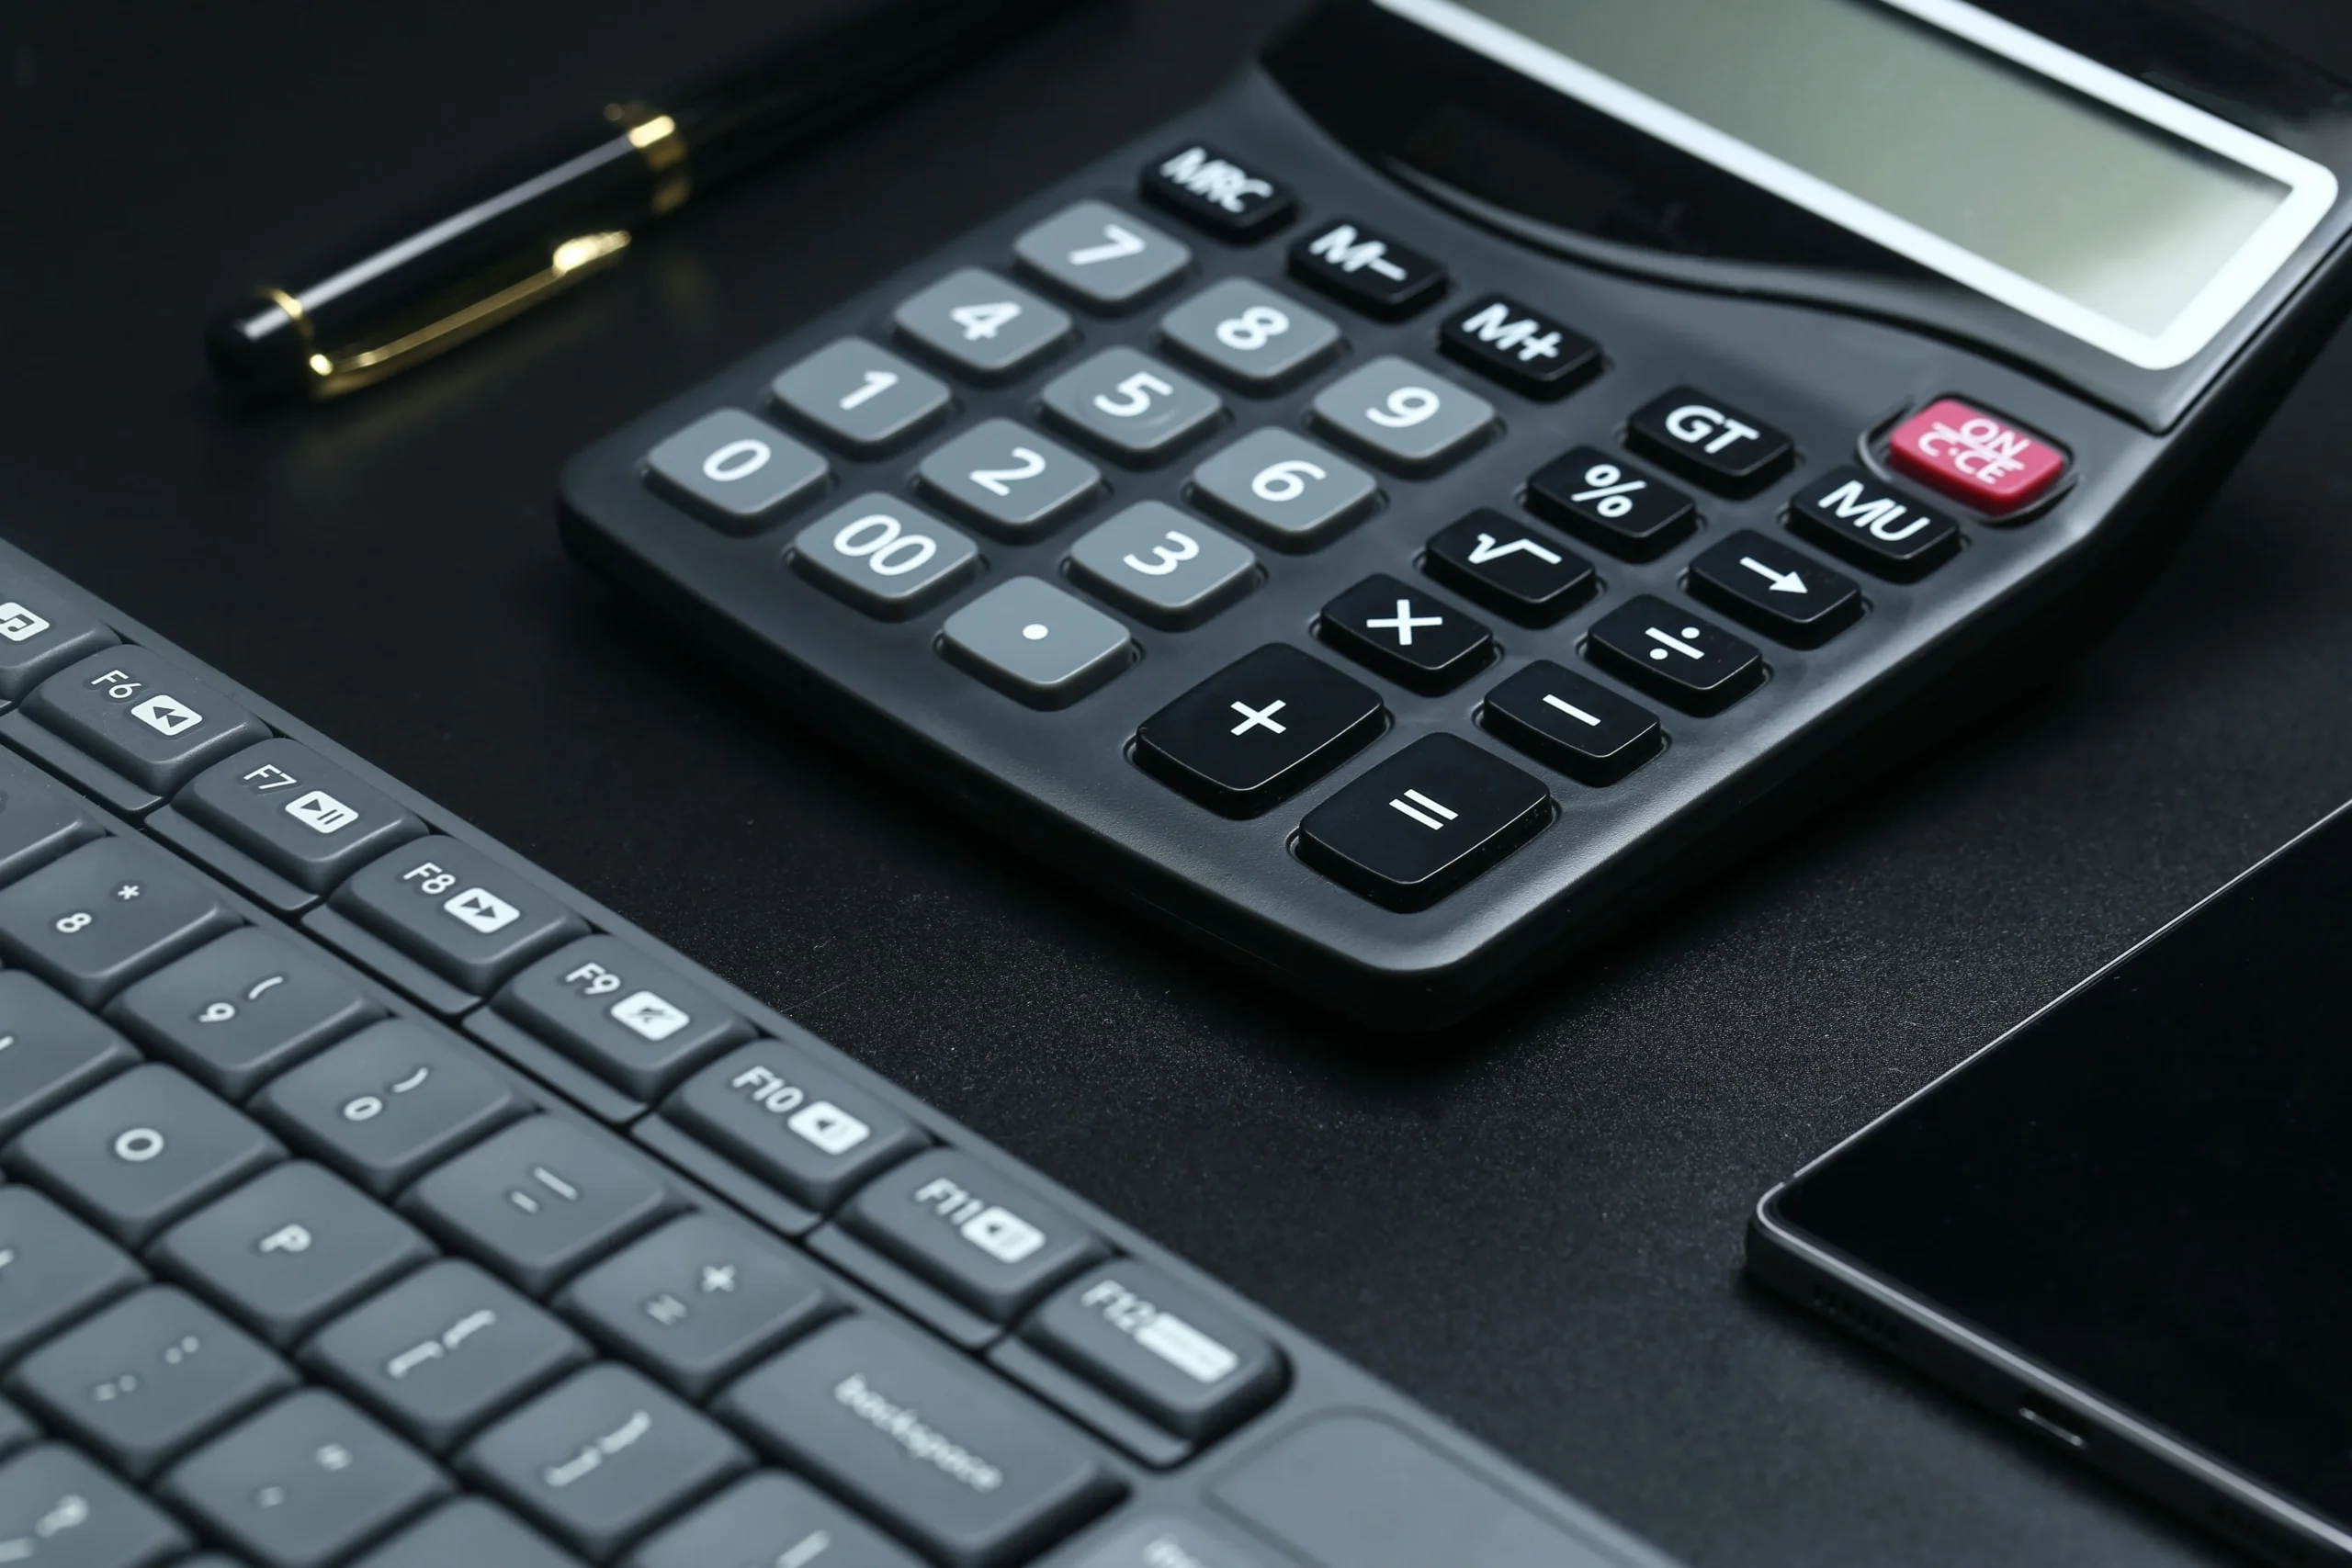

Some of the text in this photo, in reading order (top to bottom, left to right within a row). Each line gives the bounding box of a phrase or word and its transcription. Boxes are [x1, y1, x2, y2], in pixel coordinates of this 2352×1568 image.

[1161, 147, 1272, 213] MRC
[1069, 224, 1146, 265] 7
[950, 301, 1022, 341] 4
[1216, 306, 1290, 351] 8
[1462, 302, 1562, 362] M+
[840, 371, 899, 410] 1
[1093, 372, 1174, 417] 5
[1366, 387, 1441, 428] 9
[1665, 405, 1759, 454] GT
[1959, 418, 2031, 461] ON
[703, 439, 772, 481] 0
[969, 447, 1046, 496] 2
[1251, 460, 1327, 502] 6
[1571, 464, 1646, 518] %
[1817, 479, 1930, 541] MU
[832, 514, 937, 576] 00
[1123, 530, 1200, 576] 3
[91, 670, 142, 699] F6
[243, 763, 297, 790] F7
[403, 862, 456, 895] F8
[56, 912, 92, 933] 8
[566, 963, 620, 995] F9
[199, 1002, 235, 1022] 9
[732, 1066, 803, 1113] F10
[915, 1177, 985, 1224] F11
[260, 1224, 311, 1252] P
[1080, 1279, 1156, 1335] F12
[834, 1373, 1002, 1492] backspace
